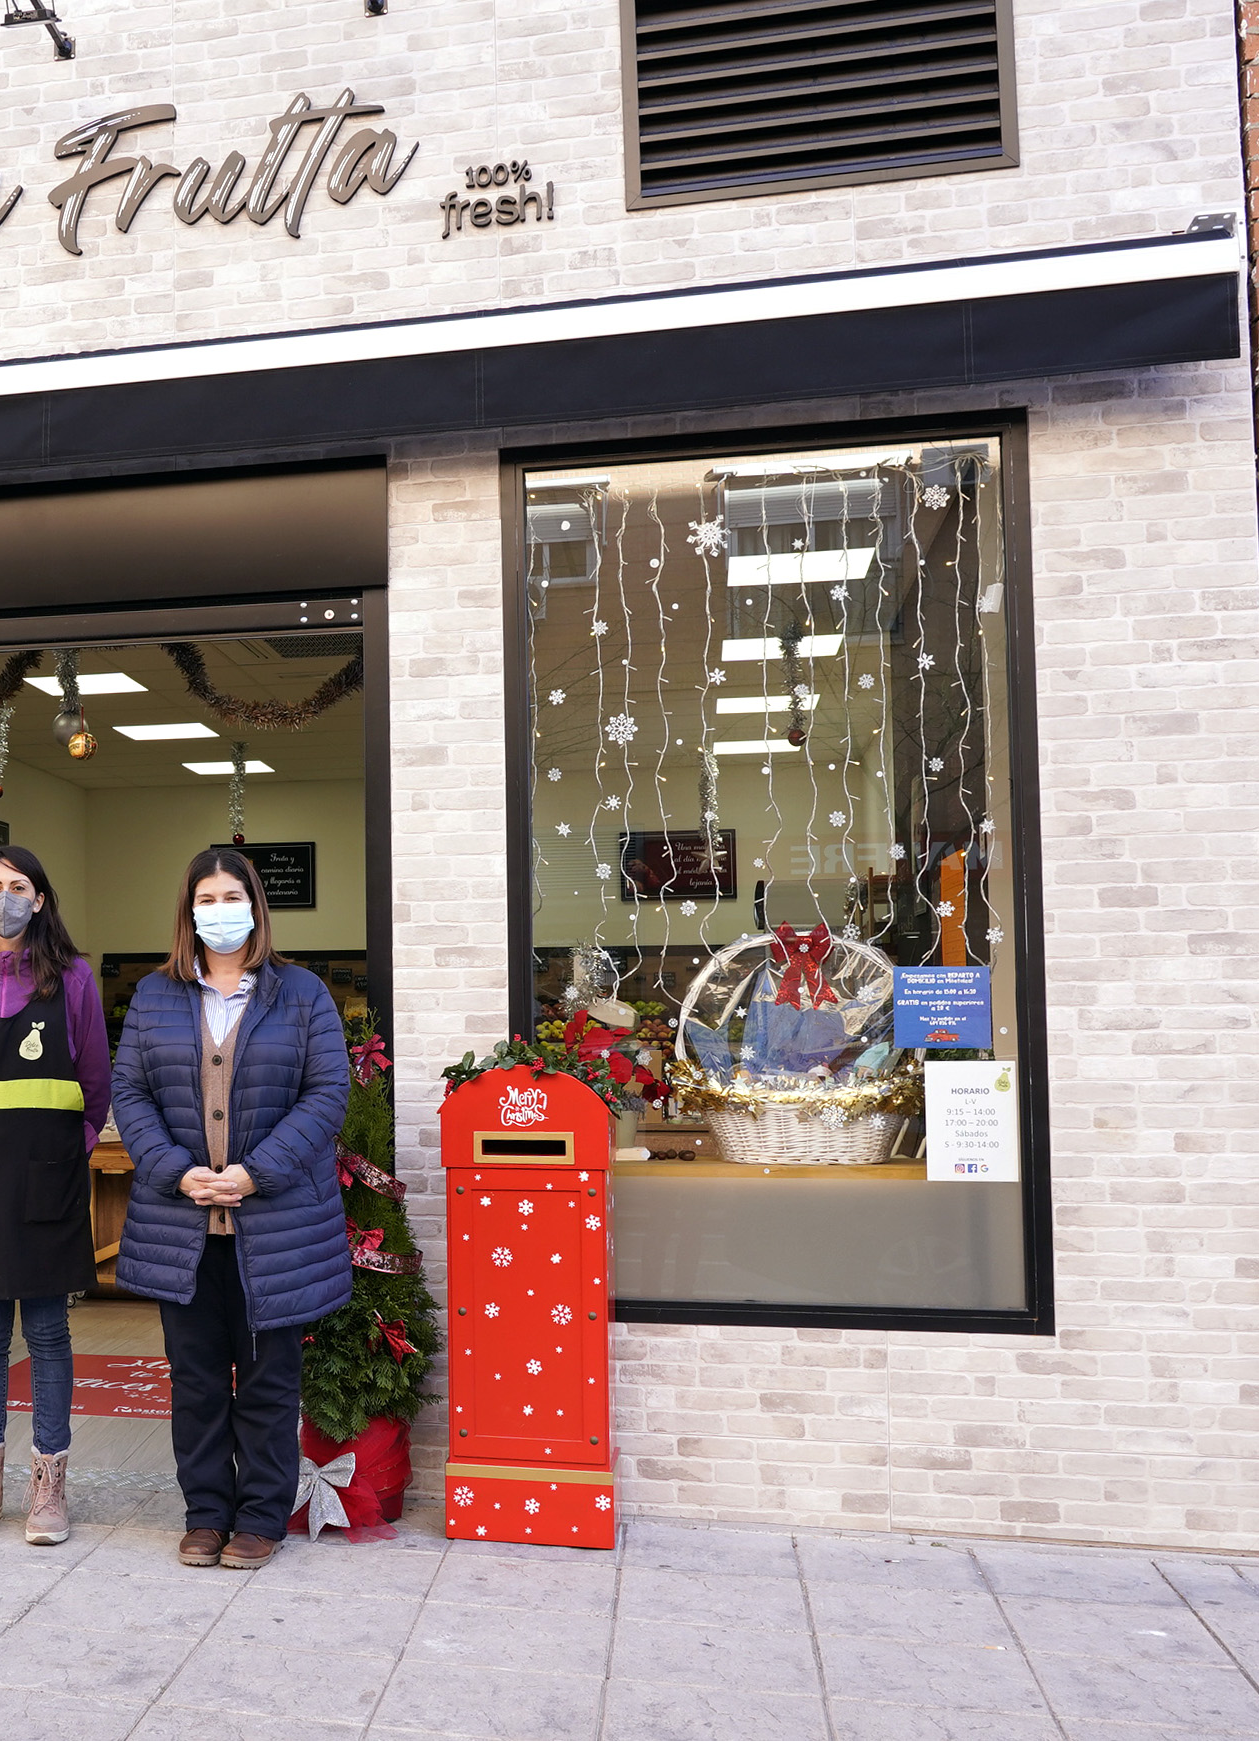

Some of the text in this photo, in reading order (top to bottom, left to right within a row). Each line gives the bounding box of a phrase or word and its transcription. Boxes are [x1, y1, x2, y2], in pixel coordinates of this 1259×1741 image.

[48, 87, 419, 255] Frutta
[466, 159, 532, 188] 100%
[440, 180, 554, 239] fresh!
[270, 853, 295, 865] Fruta y
[499, 1085, 548, 1111] Merry
[951, 1087, 990, 1095] HORARIO
[946, 1108, 964, 1116] 9:15
[974, 1108, 996, 1116] 14:00
[945, 1119, 967, 1127] 17:00
[975, 1119, 999, 1127] 20:00
